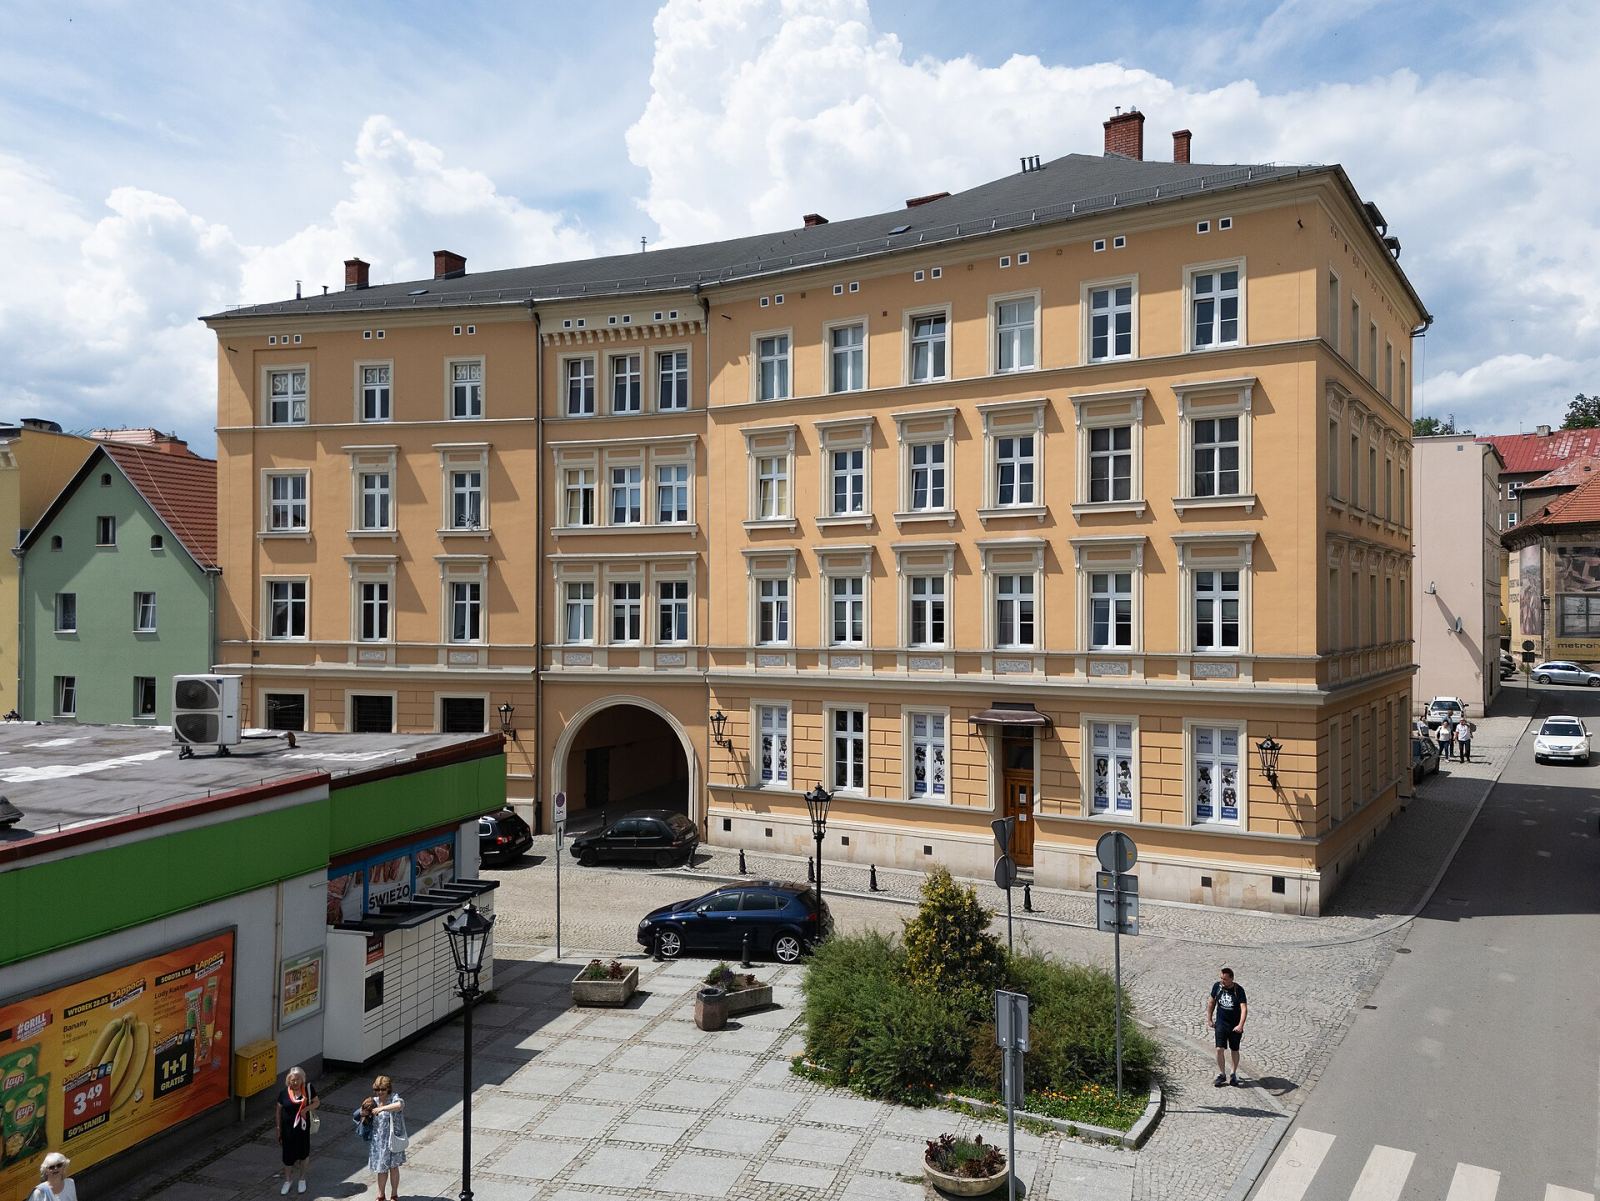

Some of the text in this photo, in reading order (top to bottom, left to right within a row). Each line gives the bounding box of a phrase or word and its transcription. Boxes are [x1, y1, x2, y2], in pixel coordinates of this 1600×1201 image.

[369, 883, 410, 910] ŚWIEŻO
[160, 971, 182, 984] SOBOTA
[67, 1002, 93, 1017] WTOREK
[16, 1012, 47, 1036] #GRILL
[63, 1020, 88, 1033] Banany
[162, 1053, 187, 1080] 1+1
[160, 1073, 187, 1091] GRATIS
[73, 1083, 103, 1116] 3 49
[67, 1113, 106, 1138] 50% TANIEJ
